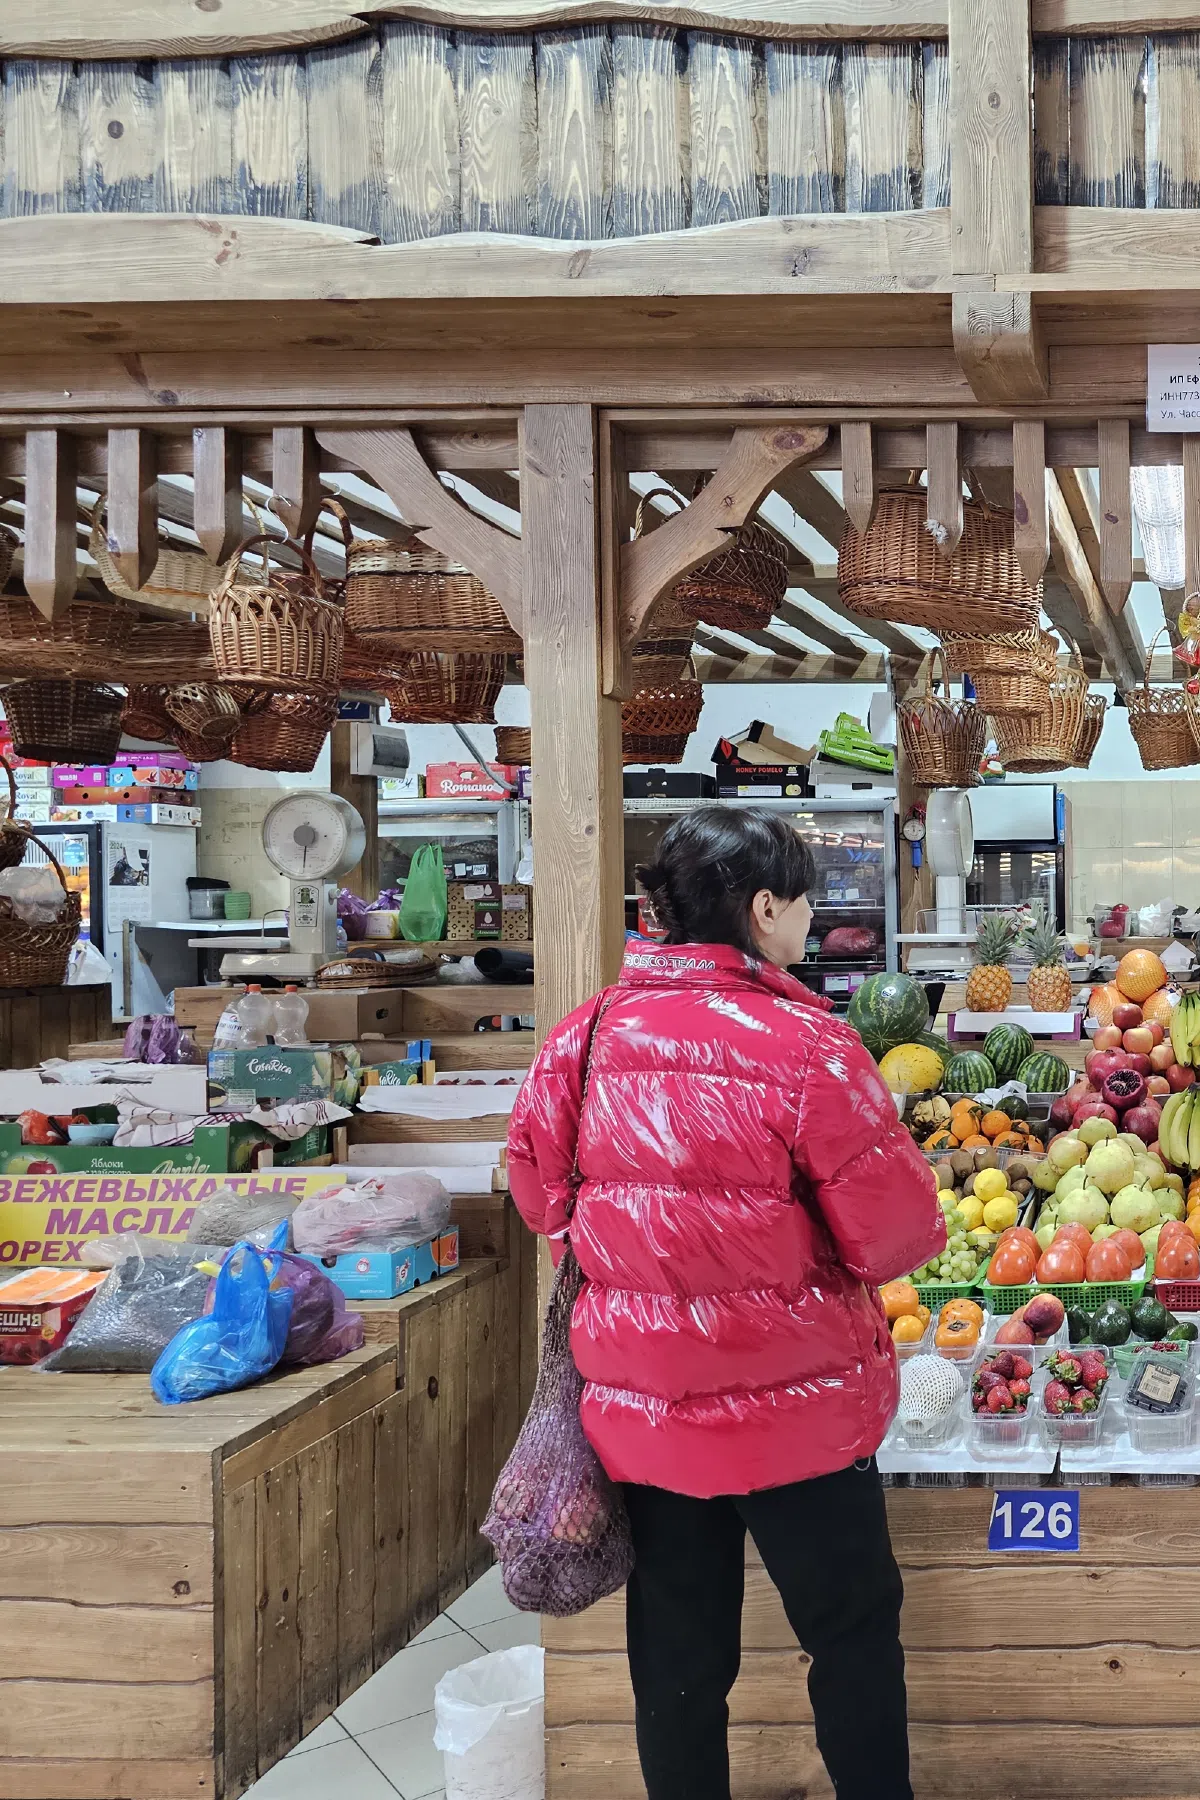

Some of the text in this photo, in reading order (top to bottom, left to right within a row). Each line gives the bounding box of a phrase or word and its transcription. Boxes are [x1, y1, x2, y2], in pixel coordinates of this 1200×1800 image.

[1169, 374, 1184, 384] ИП
[1161, 409, 1176, 419] Ул.
[13, 770, 34, 781] Royal
[440, 778, 494, 795] Romano
[15, 791, 38, 803] Royal
[90, 1157, 124, 1169] Яблоки
[45, 1207, 197, 1236] МАСЛА
[995, 1501, 1073, 1539] 126
